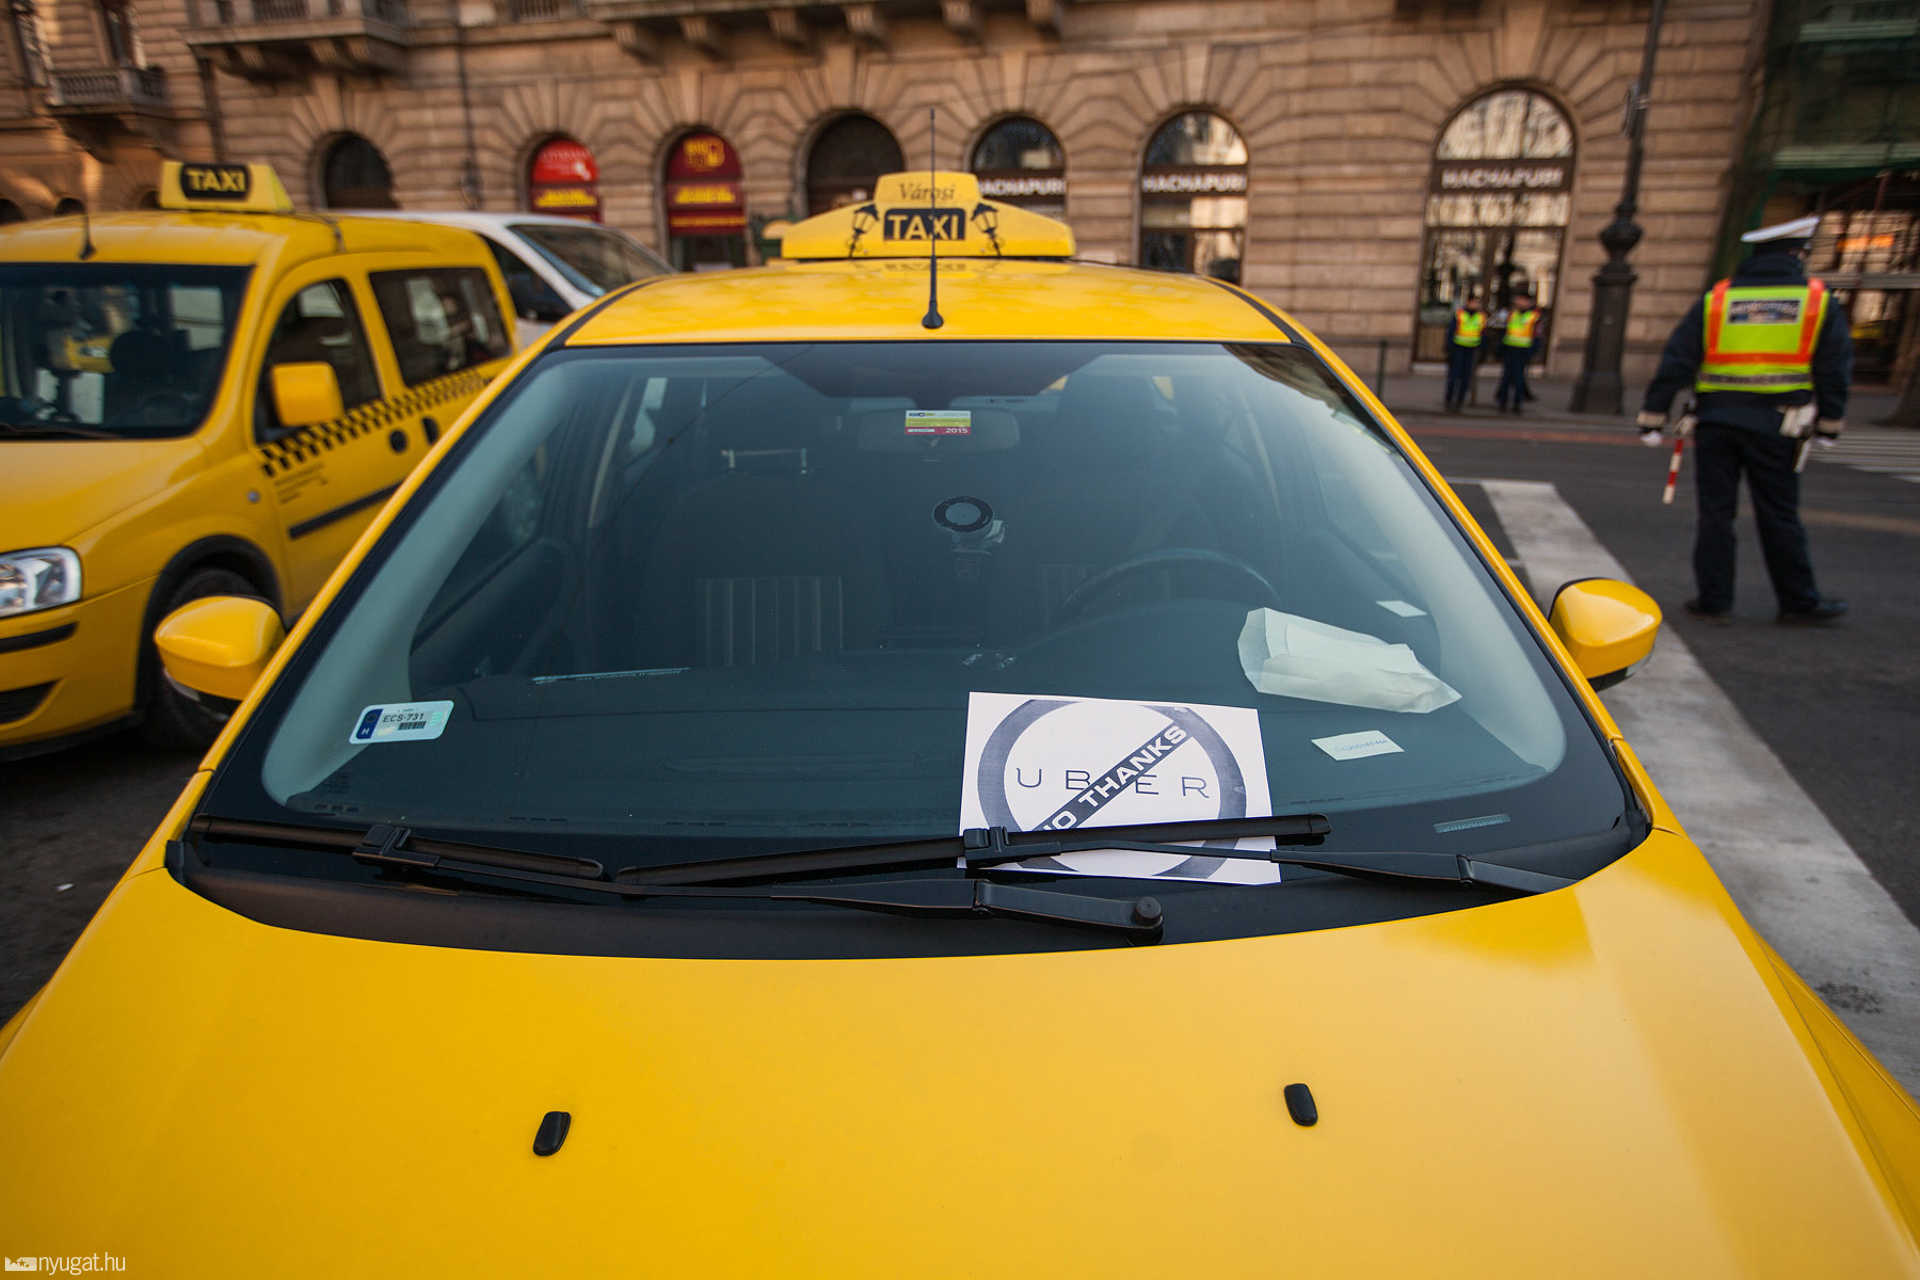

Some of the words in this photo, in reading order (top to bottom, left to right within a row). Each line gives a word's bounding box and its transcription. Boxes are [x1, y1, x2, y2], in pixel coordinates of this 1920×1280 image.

[186, 168, 246, 192] TAXI
[978, 178, 1065, 196] ACHAPURI
[899, 182, 956, 200] Városi
[887, 214, 959, 240] TAXI
[945, 427, 969, 435] 2015
[382, 712, 425, 723] ECS-731
[1016, 766, 1211, 799] UBER
[1043, 810, 1078, 831] O
[1078, 725, 1188, 808] THANKS
